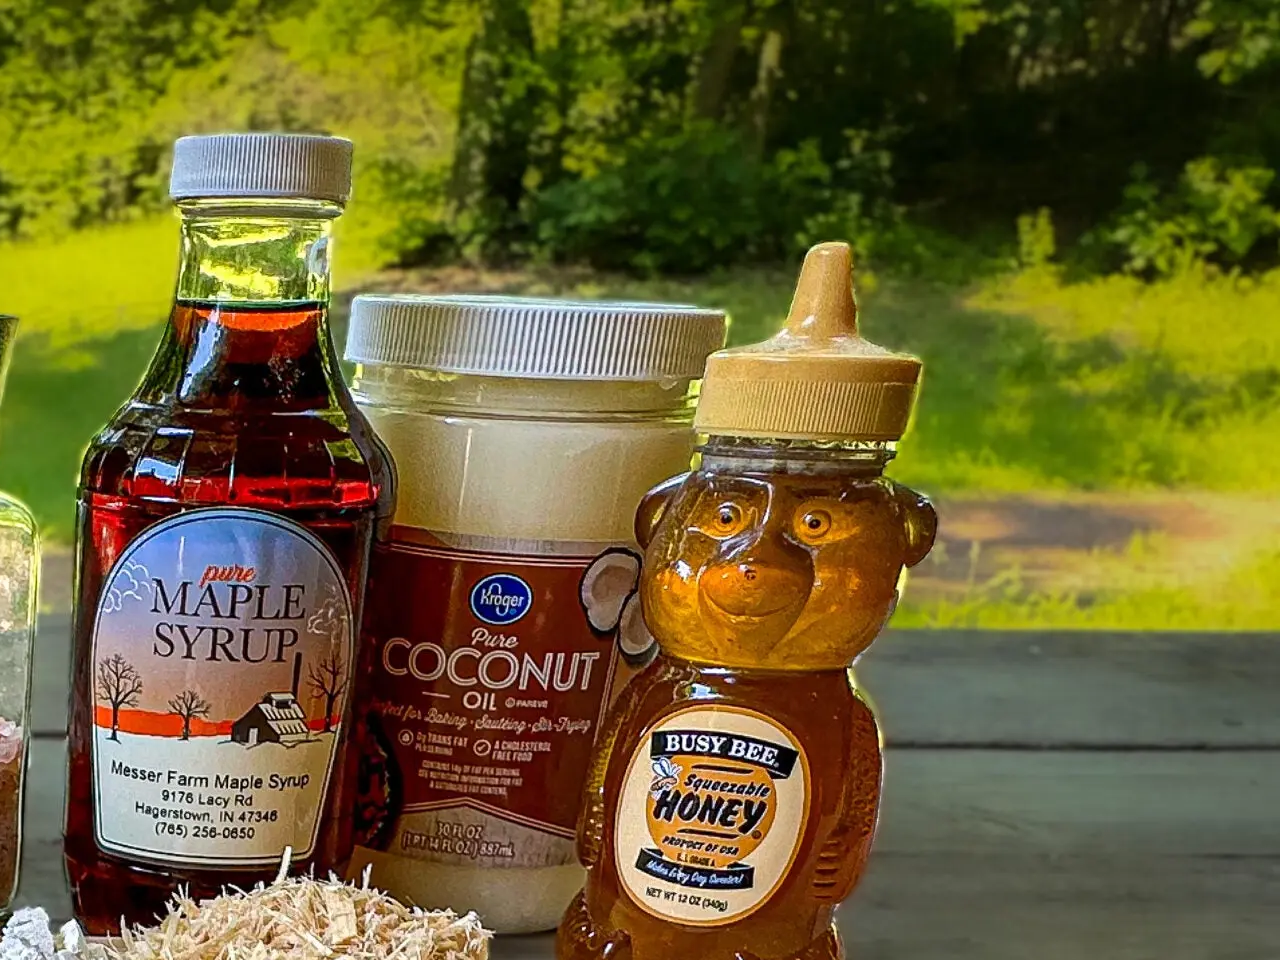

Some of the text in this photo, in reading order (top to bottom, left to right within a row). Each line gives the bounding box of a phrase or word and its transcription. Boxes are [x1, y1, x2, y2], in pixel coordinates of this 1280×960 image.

[199, 563, 256, 589] pure
[150, 578, 306, 620] MAPLE
[480, 583, 525, 616] Kroger
[153, 622, 299, 663] SYRUP
[471, 627, 519, 648] Pure
[382, 637, 600, 692] COCONUT
[463, 691, 497, 711] OIL
[424, 708, 468, 729] Baking
[428, 732, 452, 745] TRANS
[453, 736, 468, 748] FAT
[494, 741, 551, 752] A CHOLESTEROL
[665, 734, 779, 766] BUSY BEE
[492, 751, 533, 762] FREE FOOD
[111, 759, 310, 792] Messer Farm Maple Syrup
[684, 774, 771, 797] Squeezable
[161, 790, 253, 808] 9176 Lacy Rd
[135, 801, 214, 823] Hagerstown,
[219, 810, 234, 822] IN
[653, 789, 767, 834] HONEY
[155, 822, 188, 838] (765)
[466, 824, 482, 839] OZ
[705, 842, 718, 852] OF
[720, 845, 740, 856] USA
[646, 887, 661, 898] NET
[664, 889, 676, 901] WT
[678, 894, 688, 903] 12
[689, 895, 702, 905] OZ
